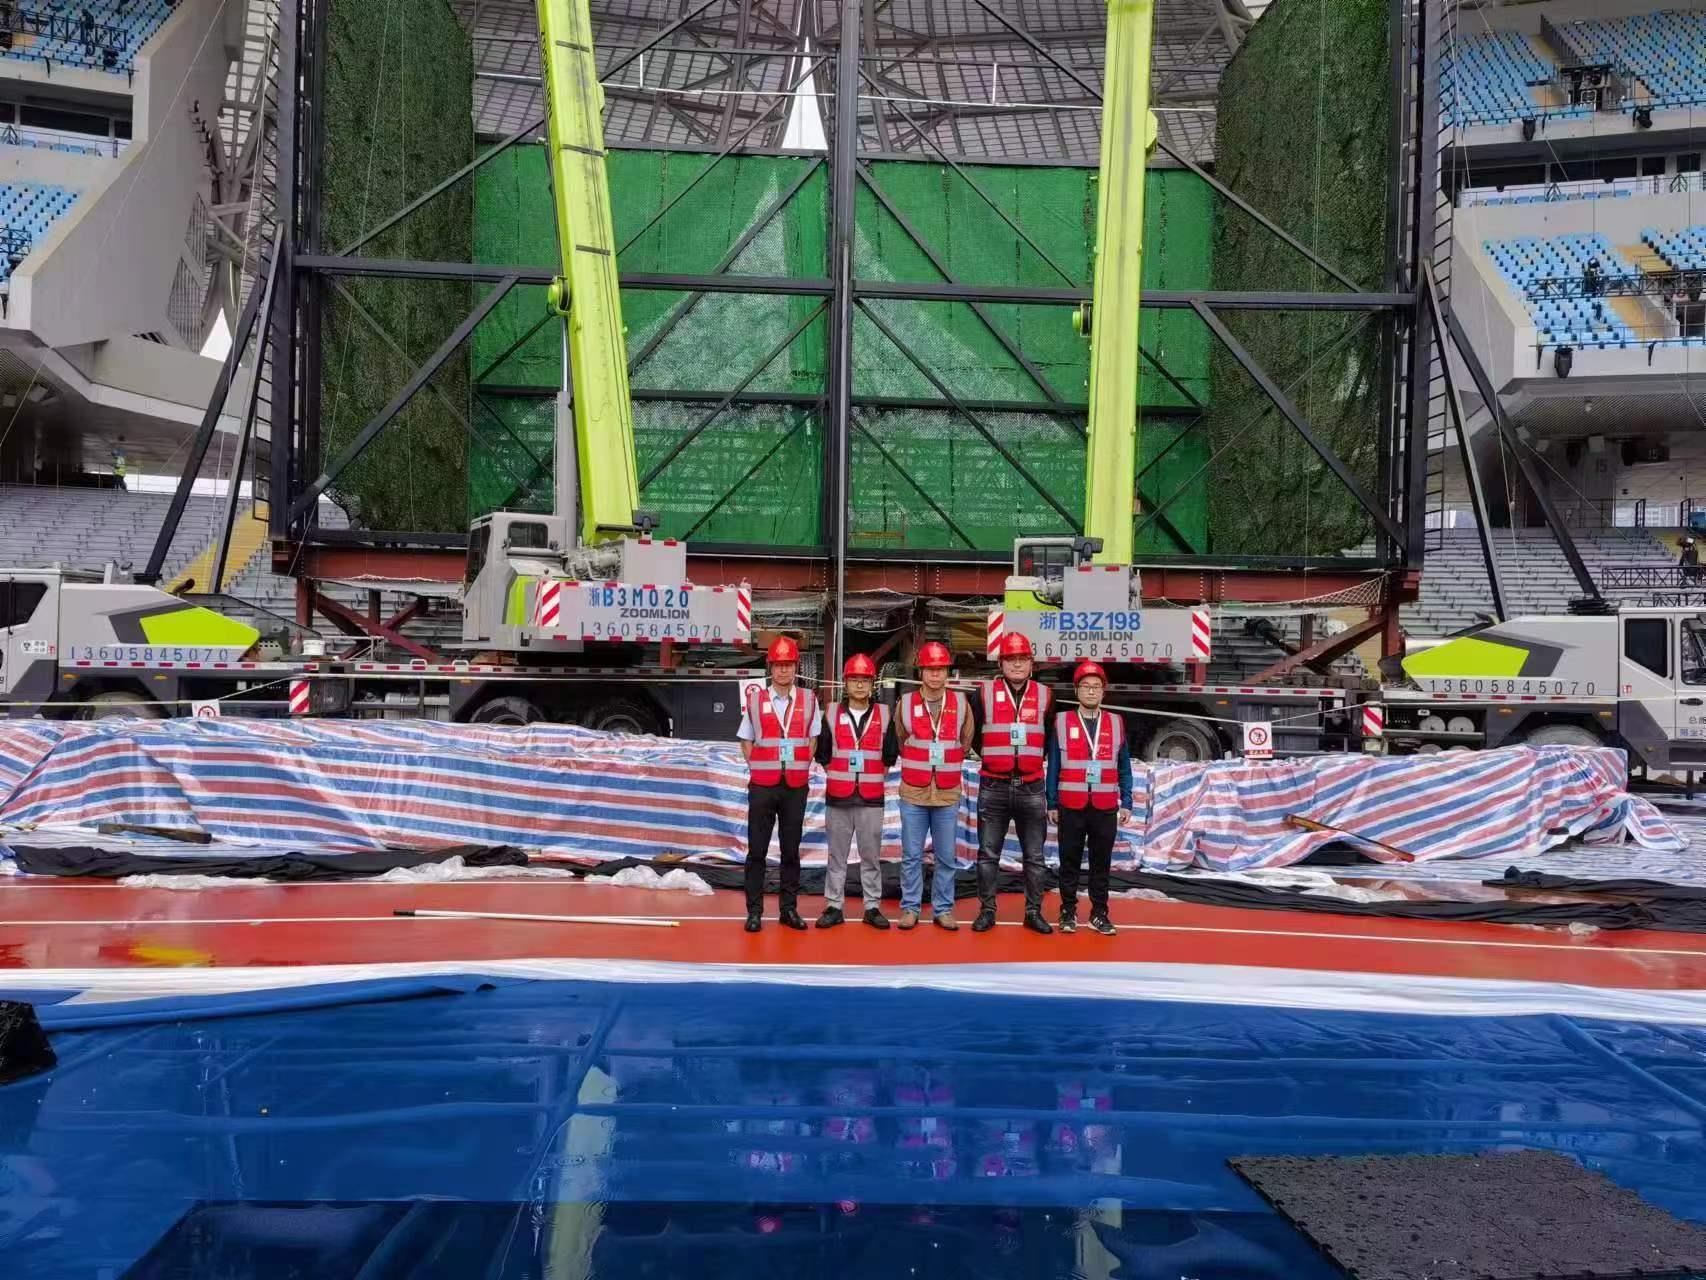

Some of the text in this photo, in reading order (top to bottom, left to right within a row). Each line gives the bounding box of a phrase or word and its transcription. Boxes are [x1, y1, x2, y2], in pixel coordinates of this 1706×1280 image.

[620, 608, 690, 620] ZOOMLION
[1039, 611, 1141, 631] 浙B3Z198
[581, 621, 721, 638] 13605845070
[1059, 631, 1133, 641] ZOOMLION
[70, 646, 229, 662] 13605845070
[1030, 642, 1173, 657] 3605845070
[1429, 679, 1596, 696] 13605845070
